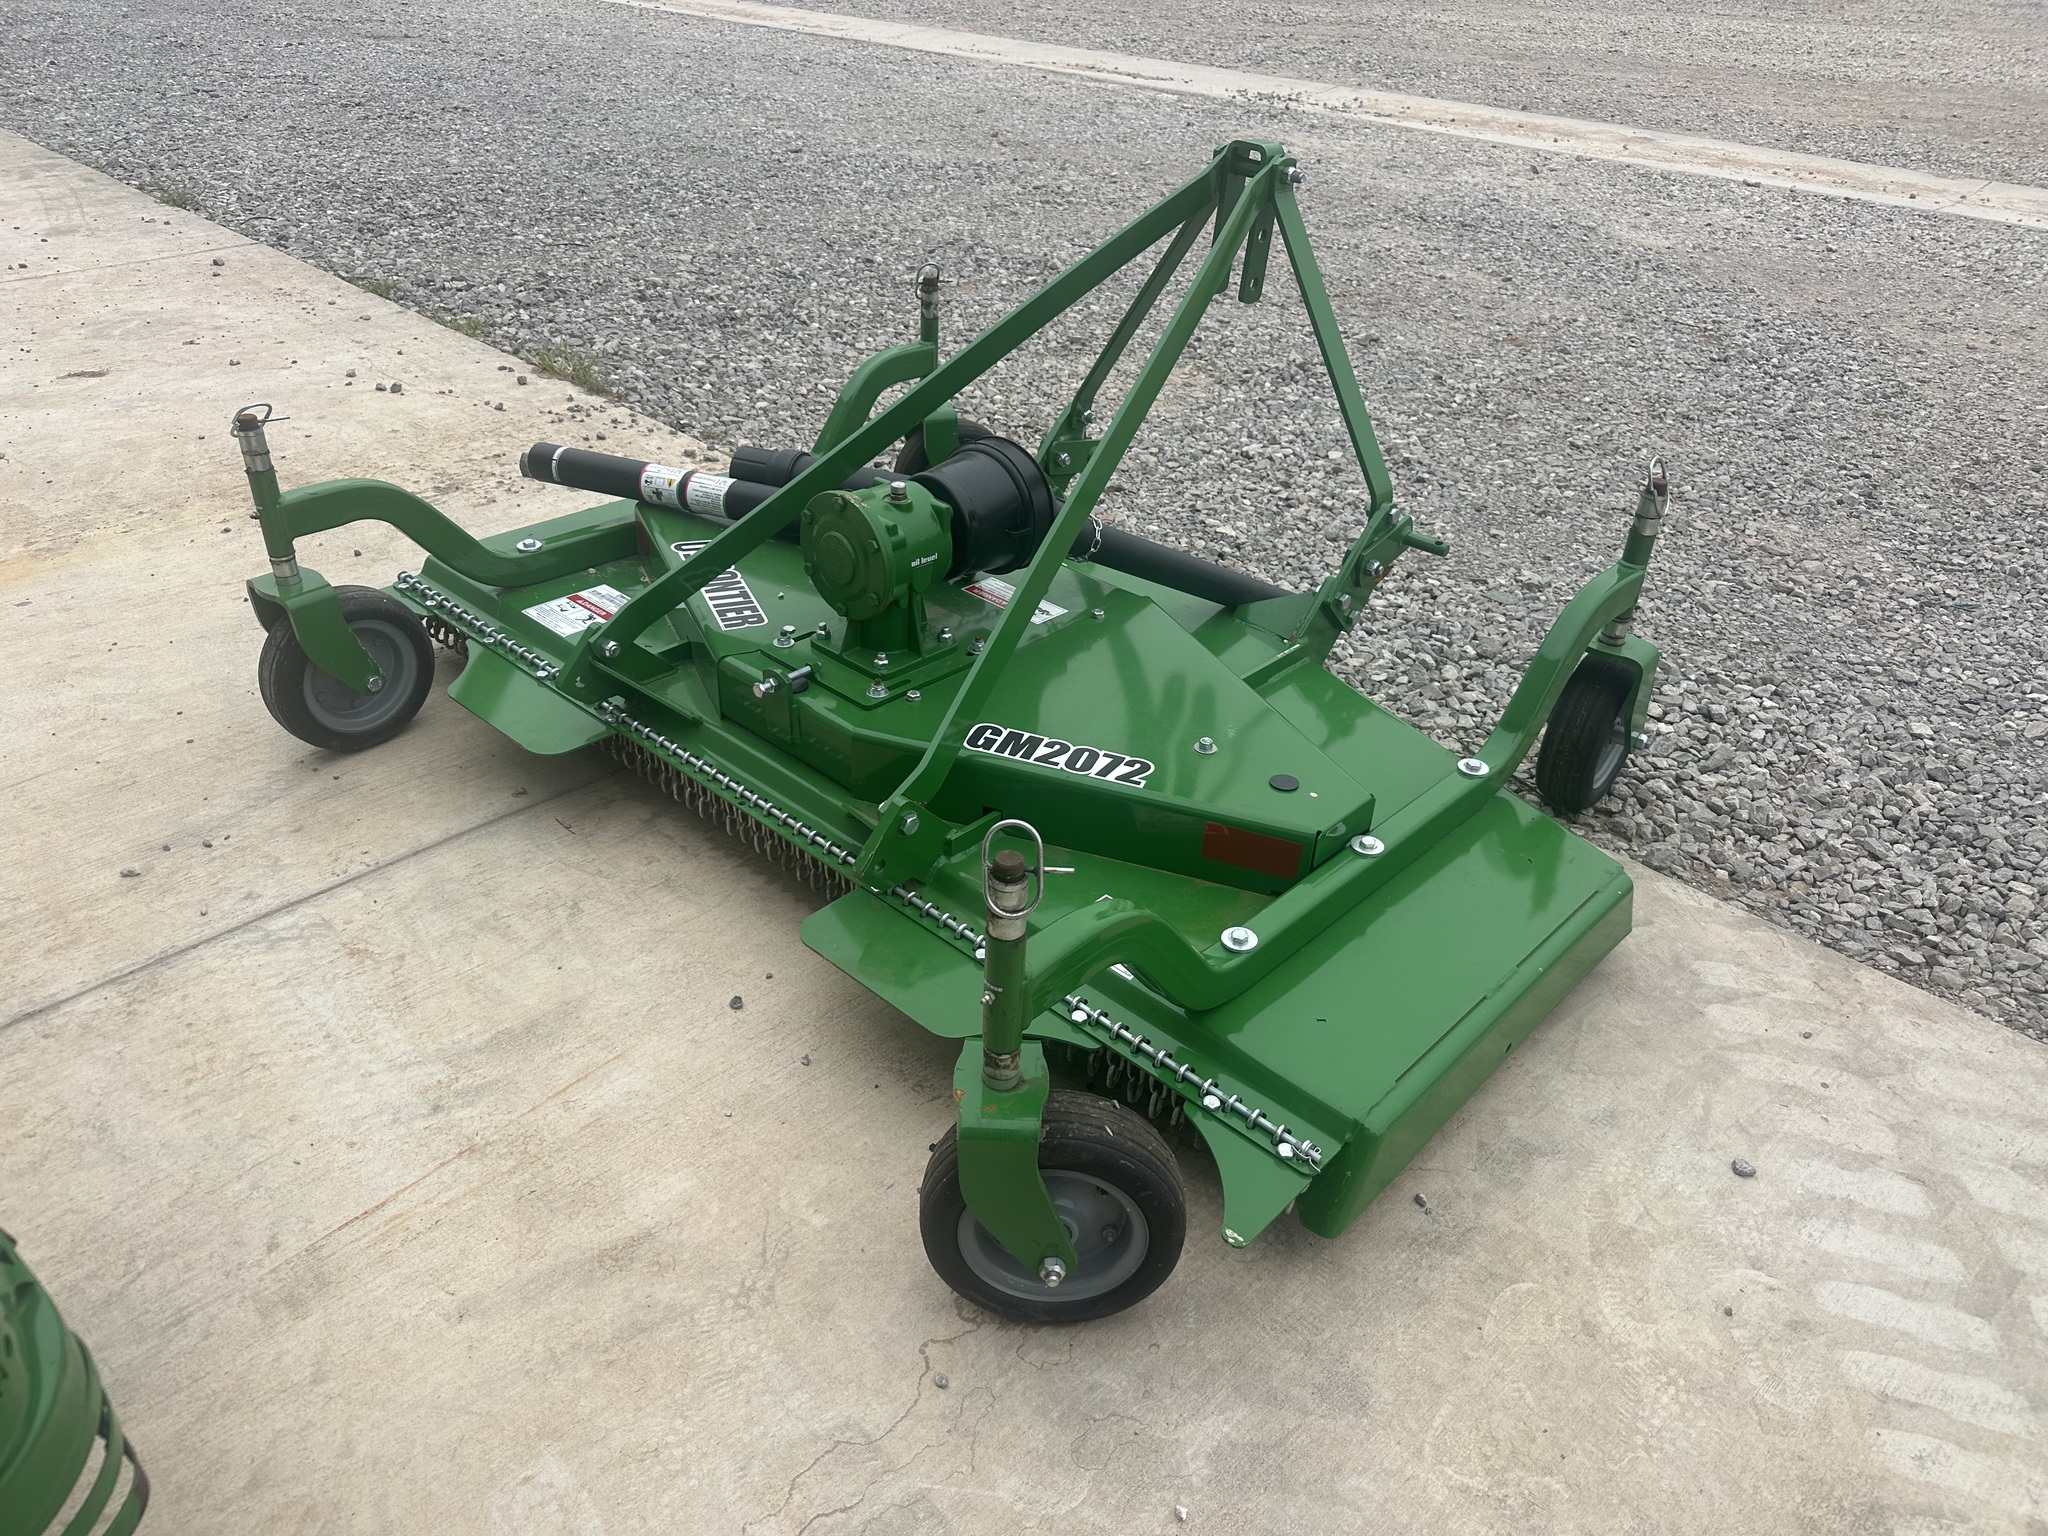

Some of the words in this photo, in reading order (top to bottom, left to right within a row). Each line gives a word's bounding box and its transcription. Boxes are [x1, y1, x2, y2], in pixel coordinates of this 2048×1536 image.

[911, 558, 920, 568] oil
[582, 600, 607, 616] DANGER
[966, 724, 1152, 786] GM2072
